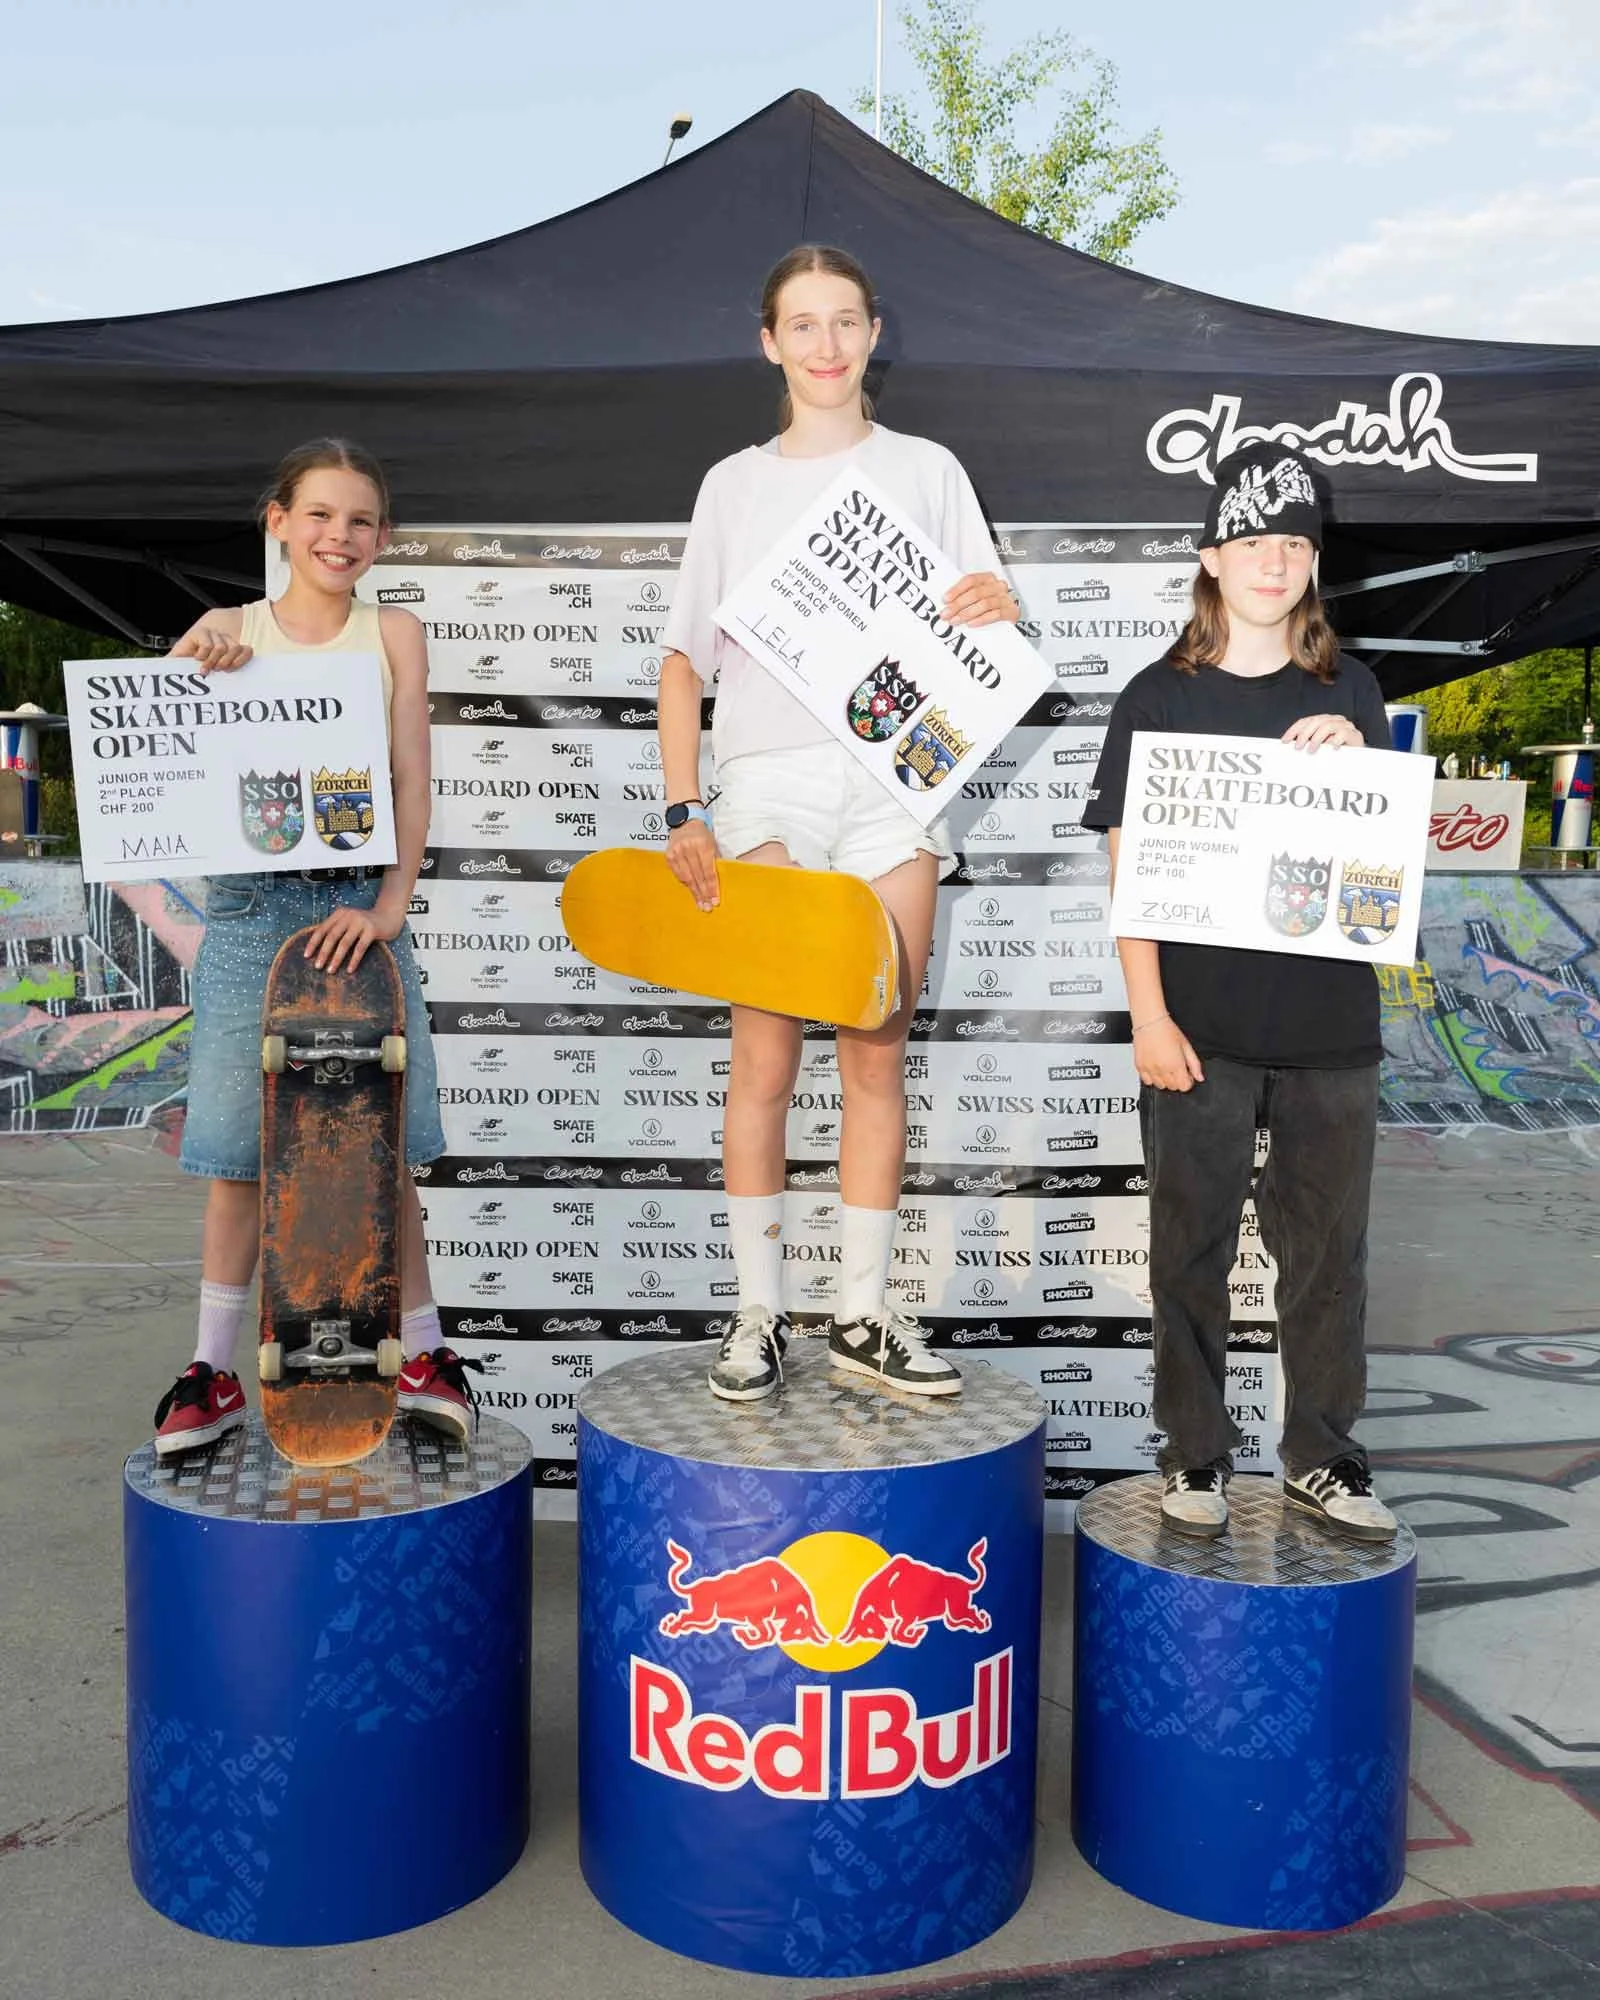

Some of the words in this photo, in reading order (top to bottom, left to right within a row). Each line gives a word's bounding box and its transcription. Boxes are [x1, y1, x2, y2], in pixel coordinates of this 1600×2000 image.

[843, 489, 935, 582] SWISS
[454, 539, 516, 560] doodah
[541, 543, 602, 561] Certo
[1053, 538, 1116, 554] Certo
[807, 531, 888, 612] OPEN
[378, 590, 424, 602] SHORLEY
[550, 584, 591, 596] SKATE
[788, 557, 828, 595] JUNIOR
[828, 592, 868, 632] WOMEN
[792, 579, 829, 614] PLACE
[1059, 588, 1108, 601] SHORLEY
[568, 598, 591, 608] .CH
[770, 578, 794, 598] CHF
[793, 599, 812, 618] 400
[824, 510, 1001, 690] SKATEBOARD
[422, 622, 525, 643] TEBOARD
[533, 624, 600, 643] OPEN
[1050, 620, 1188, 638] SKATEBOA
[751, 613, 805, 670] LELA
[550, 658, 592, 669] SKATE
[1058, 663, 1106, 675] SHORLEY
[568, 671, 592, 682] .CH
[87, 673, 211, 700] SWISS
[874, 666, 918, 710] SSO
[90, 697, 343, 730] SKATEBOARD
[460, 700, 518, 720] doodah
[541, 704, 602, 721] Certo
[93, 732, 197, 760] OPEN
[552, 744, 593, 756] SKATE
[570, 756, 593, 768] .CH
[1148, 747, 1262, 776] SWISS
[97, 771, 149, 785] JUNIOR
[154, 769, 206, 782] WOMEN
[100, 788, 117, 800] 2nd
[120, 786, 166, 798] PLACE
[244, 782, 298, 800] SSO
[538, 782, 600, 800] OPEN
[962, 782, 1038, 800] SWISS
[1144, 774, 1388, 817] SKATEBOARD
[100, 804, 127, 815] CHF
[132, 802, 154, 813] 200
[555, 813, 596, 825] SKATE
[1142, 802, 1238, 830] OPEN
[573, 826, 596, 837] .CH
[122, 834, 190, 860] MAIA
[1140, 838, 1186, 850] JUNIOR
[1190, 842, 1239, 854] WOMEN
[1155, 852, 1196, 865] PLACE
[1136, 866, 1161, 877] CHF
[1166, 868, 1185, 879] 100
[1272, 864, 1328, 885] SSO
[1141, 901, 1213, 925] ZSOFIA
[960, 940, 1036, 958] SWISS
[554, 966, 596, 978] SKATE
[572, 979, 596, 990] .CH
[1050, 983, 1100, 994] SHORLEY
[458, 1008, 520, 1028] doodah
[545, 1012, 604, 1027] Certo
[622, 1011, 683, 1031] doodah
[554, 1050, 595, 1061] SKATE
[572, 1062, 595, 1073] .CH
[629, 1068, 676, 1076] VOLCOM
[906, 1068, 928, 1080] .CH
[1050, 1068, 1099, 1080] SHORLEY
[437, 1087, 528, 1106] EBOARD
[536, 1088, 600, 1106] OPEN
[624, 1090, 698, 1107] SWISS
[958, 1096, 1034, 1114] SWISS
[554, 1120, 594, 1131] SKATE
[571, 1132, 594, 1144] .CH
[628, 1138, 676, 1146] VOLCOM
[1048, 1138, 1097, 1150] SHORLEY
[962, 1145, 1010, 1153] VOLCOM
[457, 1162, 519, 1182] doodah
[544, 1165, 603, 1180] Certo
[620, 1164, 682, 1184] doodah
[1042, 1174, 1100, 1190] Certo
[552, 1202, 594, 1214] SKATE
[570, 1214, 594, 1226] .CH
[627, 1221, 675, 1229] VOLCOM
[1047, 1220, 1094, 1232] SHORLEY
[903, 1222, 926, 1232] .CH
[961, 1229, 1009, 1237] VOLCOM
[424, 1240, 528, 1260] TEBOARD
[536, 1241, 600, 1258] OPEN
[622, 1242, 697, 1259] SWISS
[956, 1250, 1030, 1267] SWISS
[1038, 1249, 1148, 1267] SKATEBO
[552, 1272, 593, 1283] SKATE
[570, 1284, 593, 1295] .CH
[1045, 1289, 1091, 1300] SHORLEY
[902, 1291, 925, 1302] .CH
[1240, 1296, 1264, 1307] .CH
[458, 1314, 518, 1334] doodah
[542, 1318, 602, 1332] Certo
[620, 1316, 681, 1335] doodah
[952, 1325, 1013, 1344] doodah
[1038, 1325, 1098, 1340] Certo
[552, 1355, 592, 1366] SKATE
[570, 1366, 592, 1378] .CH
[1042, 1370, 1090, 1382] SHORLEY
[1239, 1379, 1262, 1390] .CH
[535, 1393, 576, 1409] OPE
[630, 1654, 830, 1800] Red
[841, 1646, 1012, 1799] Bull
